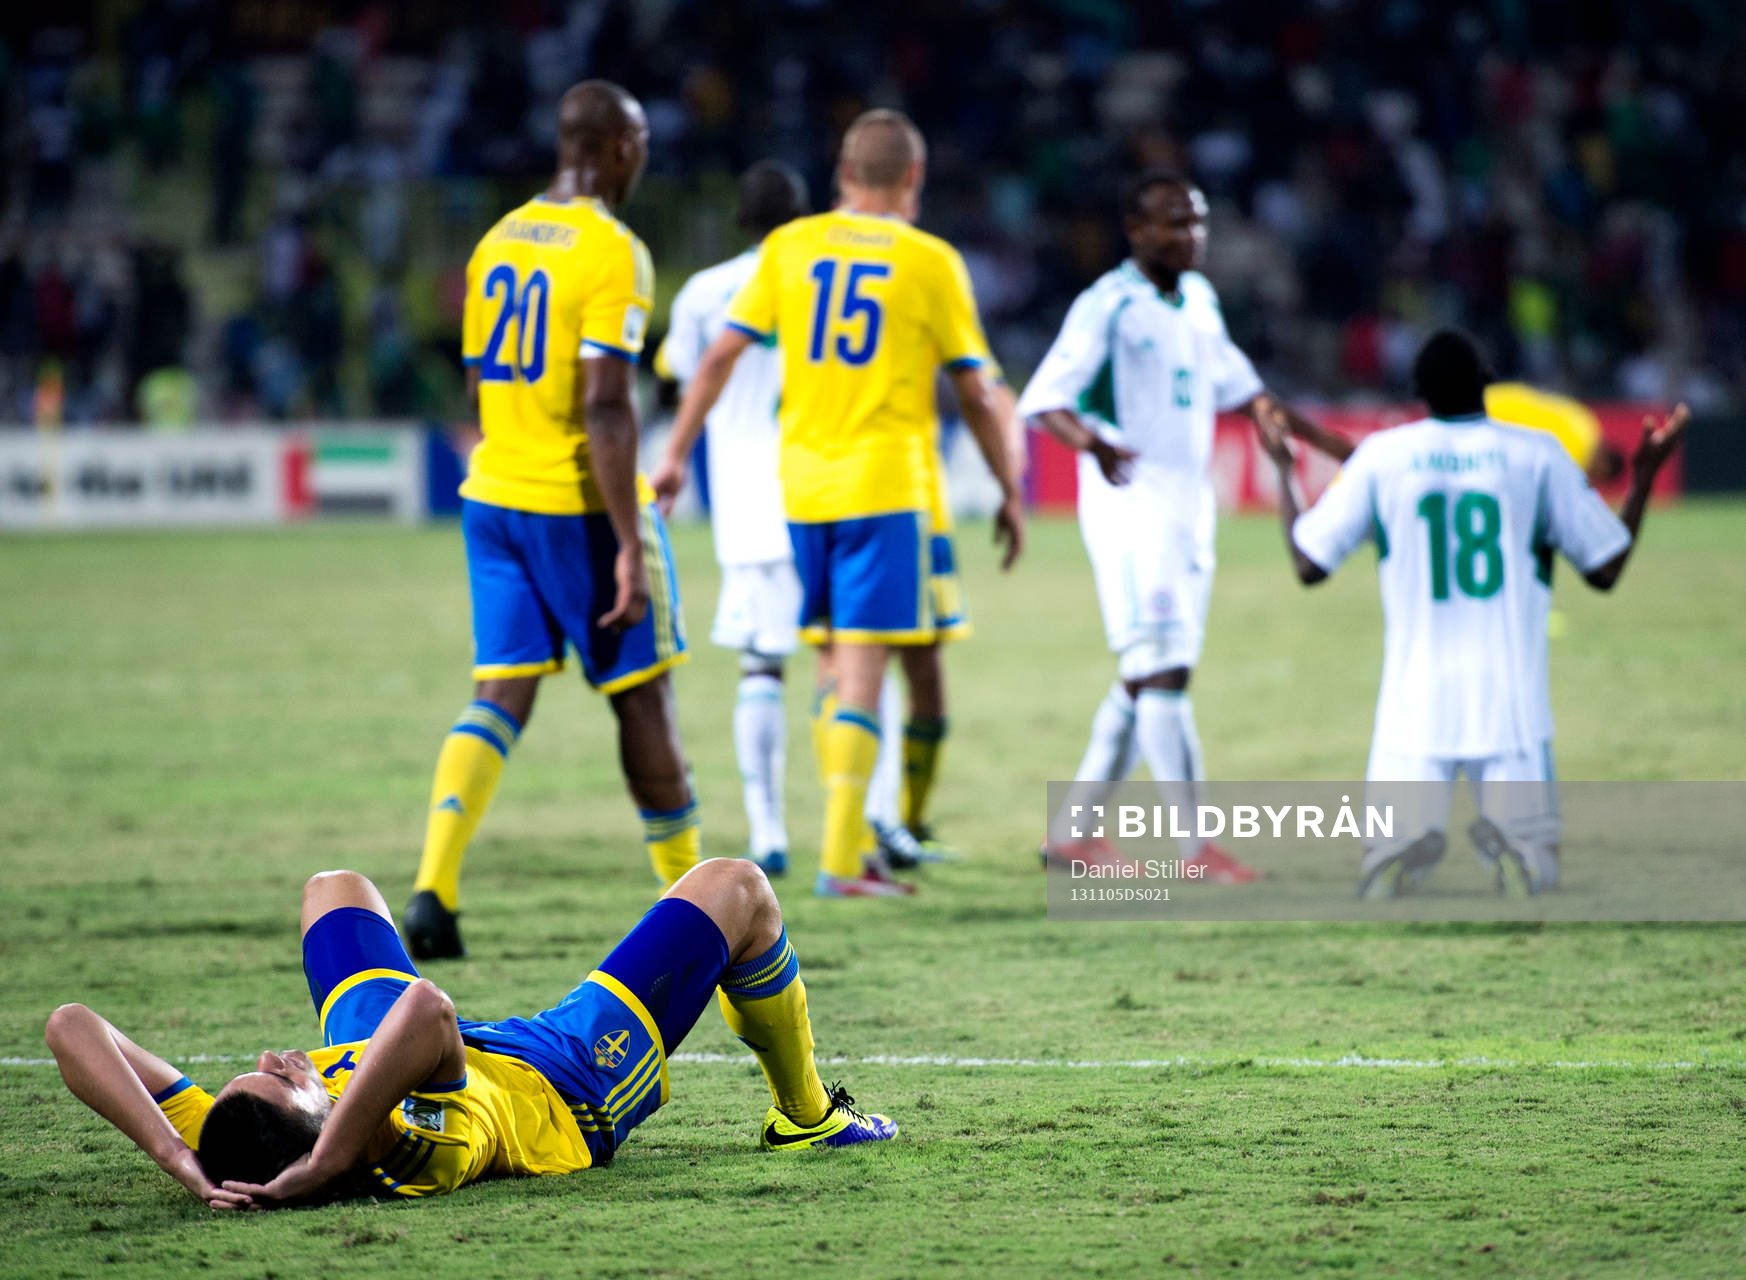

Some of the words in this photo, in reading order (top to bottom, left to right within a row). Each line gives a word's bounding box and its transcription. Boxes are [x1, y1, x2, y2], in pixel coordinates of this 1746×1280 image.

[480, 264, 548, 383] 20
[811, 260, 889, 366] 15
[1417, 490, 1504, 601] 18
